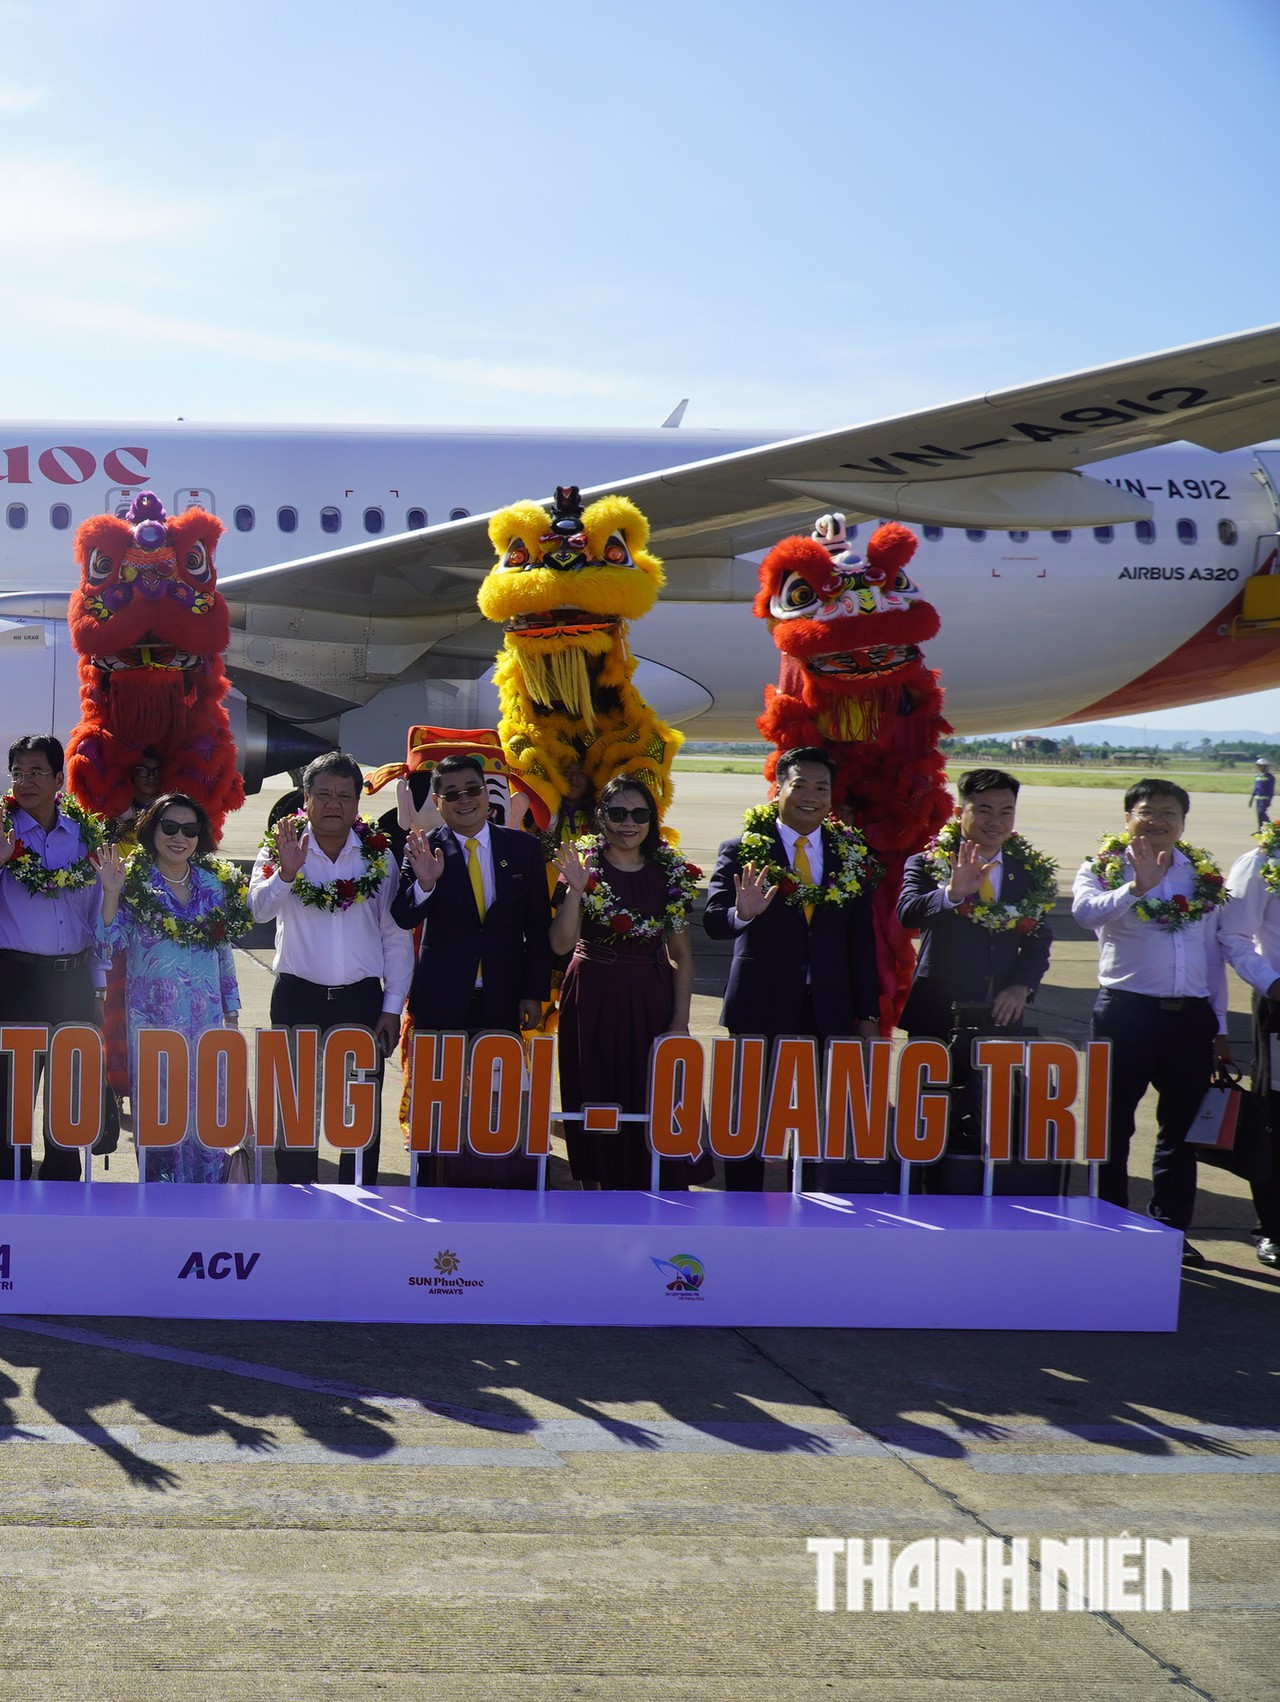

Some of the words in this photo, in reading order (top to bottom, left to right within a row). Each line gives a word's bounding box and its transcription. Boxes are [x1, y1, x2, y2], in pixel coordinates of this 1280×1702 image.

[839, 387, 1209, 476] VN-A912
[1118, 566, 1185, 581] AIRBUS
[1188, 567, 1239, 581] A320
[136, 1026, 378, 1150] DONG
[408, 1032, 556, 1157] HOI
[649, 1034, 951, 1164] QUANG
[974, 1039, 1112, 1163] TRI
[177, 1251, 261, 1280] ACV
[408, 1276, 432, 1286] SUN
